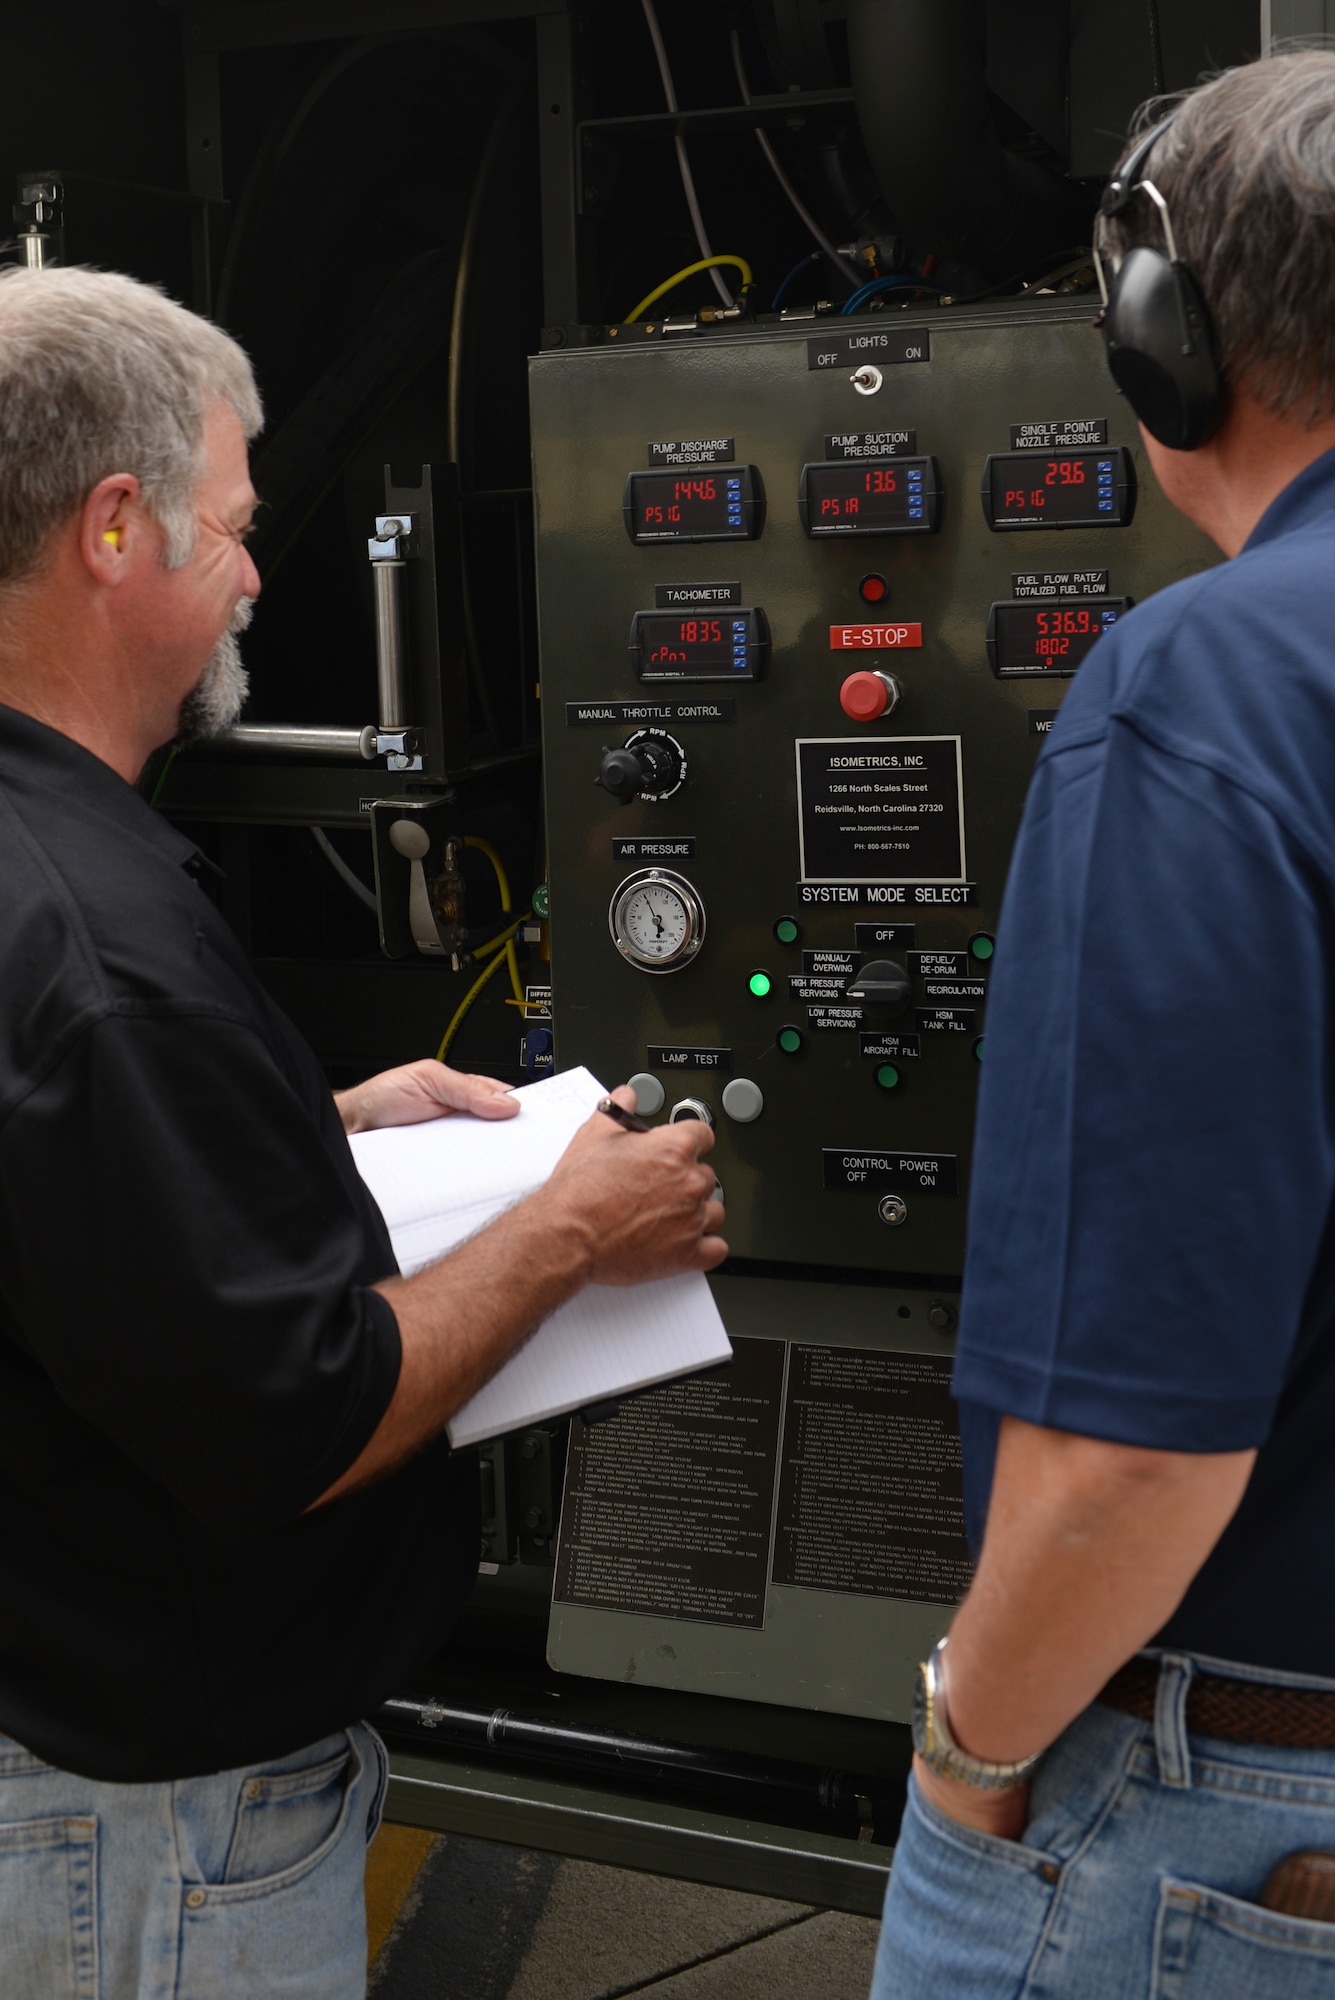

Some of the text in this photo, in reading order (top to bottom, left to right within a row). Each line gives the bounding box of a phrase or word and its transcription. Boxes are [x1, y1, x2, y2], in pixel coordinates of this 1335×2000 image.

[849, 336, 888, 349] LIGHTS
[818, 348, 921, 366] OFF ON
[1021, 422, 1095, 436] SINGLE POINT
[832, 432, 908, 446] PUMP SUCTION
[1016, 432, 1100, 448] NOZZLE PRESSURE
[653, 440, 728, 454] PUMP DISCHARGE
[844, 444, 896, 456] PRESSURE
[666, 451, 715, 464] PRESSURE
[1005, 490, 1045, 508] PSIG
[645, 506, 680, 522] PSIG
[1018, 573, 1102, 586] FUEL FLOW RATE/
[667, 589, 730, 600] TACHOMETER
[1015, 584, 1106, 596] TOTALIZED FUEL FLOW
[681, 621, 721, 642] 1835
[842, 628, 908, 646] E-STOP
[1036, 638, 1070, 654] 1802
[578, 706, 721, 719] MANUAL THROTTLE CONTROL
[650, 728, 666, 736] RPM
[830, 756, 924, 768] ISOMETRICS, INC
[828, 784, 847, 792] 1266
[903, 784, 928, 792] Street
[641, 792, 658, 802] RPM
[814, 804, 944, 814] Reidsville, North Carolina 27320
[621, 844, 689, 854] AIR PRESSURE
[802, 887, 970, 902] SYSTEM MODE SELECT
[876, 930, 895, 940] OFF
[814, 954, 850, 963] MANUAL/
[920, 956, 955, 964] DEFUEL/
[813, 964, 852, 972] OVERWING
[920, 966, 956, 974] DE-DRUM
[791, 979, 845, 988] HIGH PRESSURE
[799, 989, 838, 998] SERVICING
[927, 986, 984, 995] RECIRCULATION
[808, 1008, 863, 1018] LOW PRESSURE
[936, 1011, 953, 1020] HSM
[817, 1019, 856, 1028] SERVICING
[923, 1021, 966, 1030] TANK FILL
[882, 1037, 899, 1045] HSM
[864, 1046, 918, 1056] AIRCRAFT FILL
[662, 1053, 718, 1064] LAMP TEST
[842, 1158, 938, 1172] CONTROL POWER
[847, 1171, 936, 1186] OFF ON
